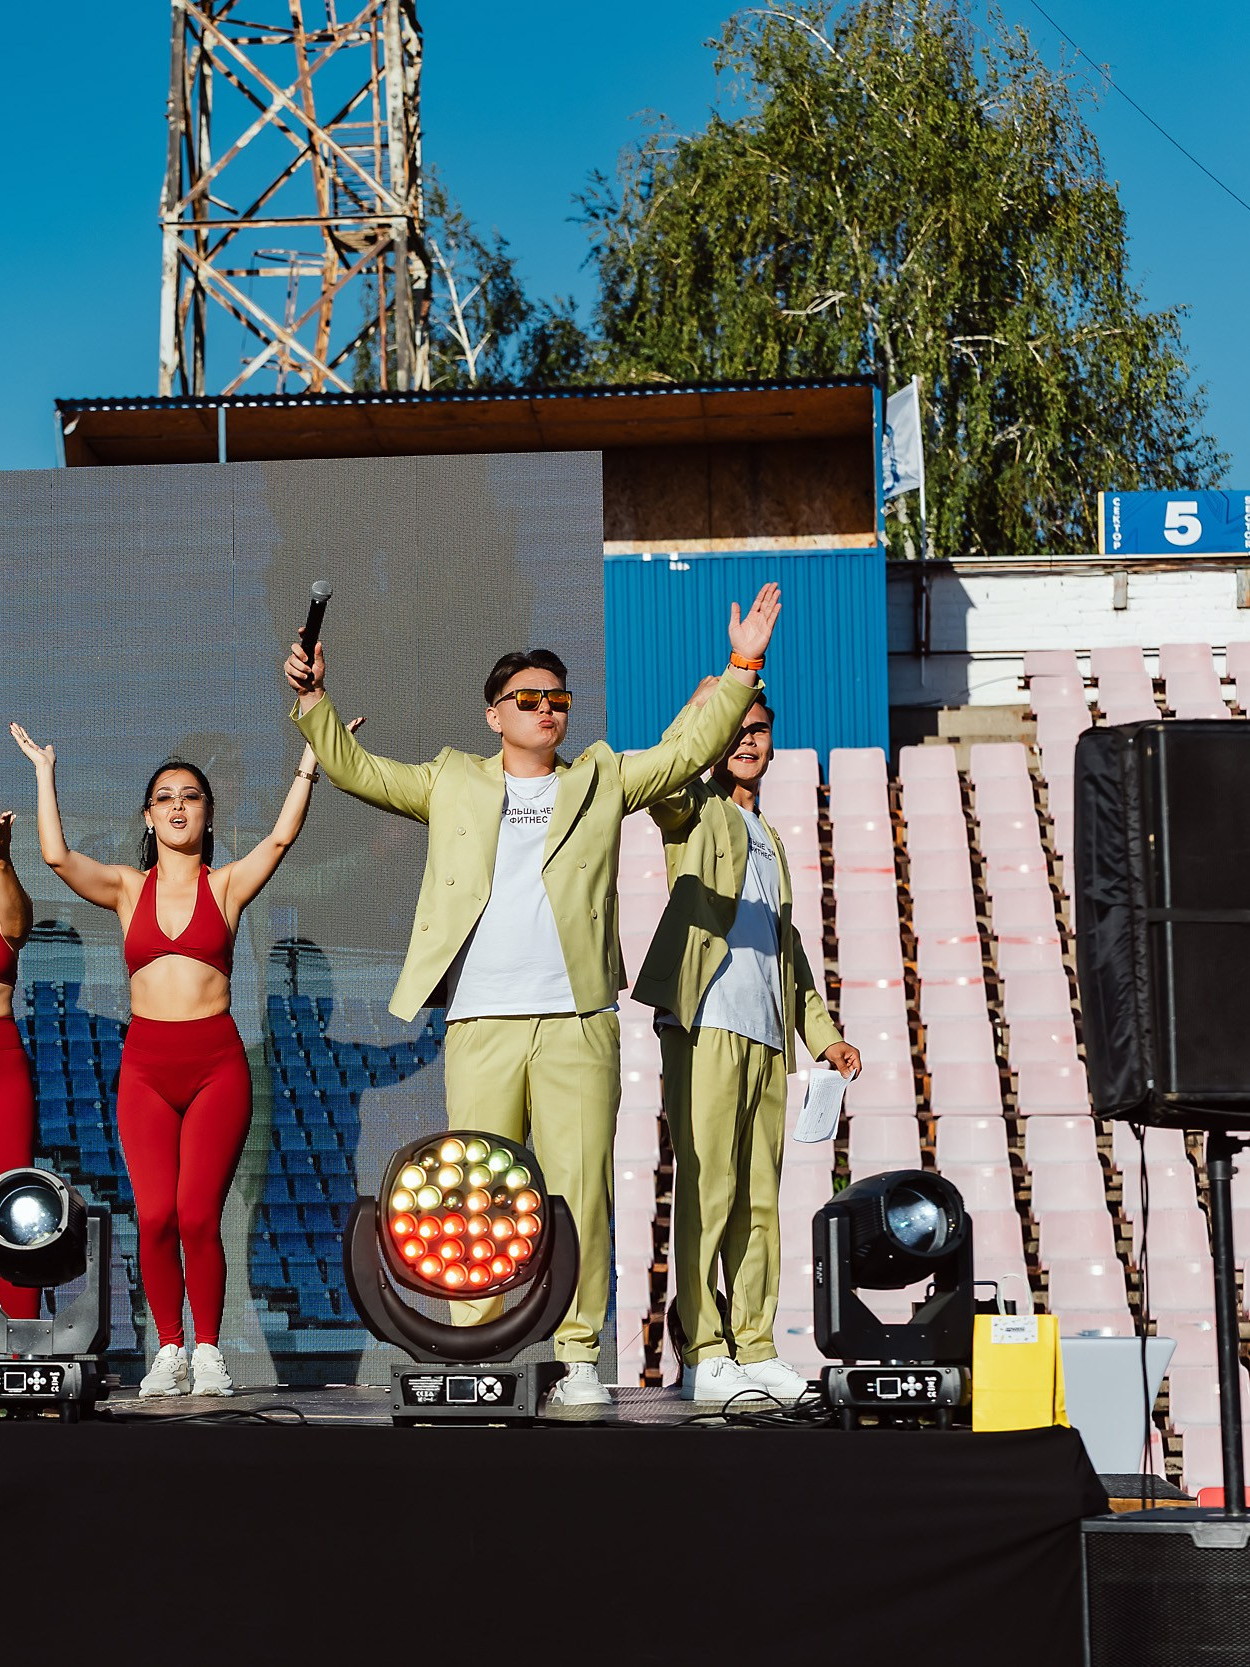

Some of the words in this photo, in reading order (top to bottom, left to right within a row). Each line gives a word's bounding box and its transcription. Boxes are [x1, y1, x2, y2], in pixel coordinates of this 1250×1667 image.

[1112, 497, 1122, 550] СЕКТОР
[1163, 500, 1203, 547] 5
[502, 807, 538, 816] ОЛЬШЕ
[540, 806, 554, 815] ЧЕ
[509, 816, 548, 824] ФИТНЕС
